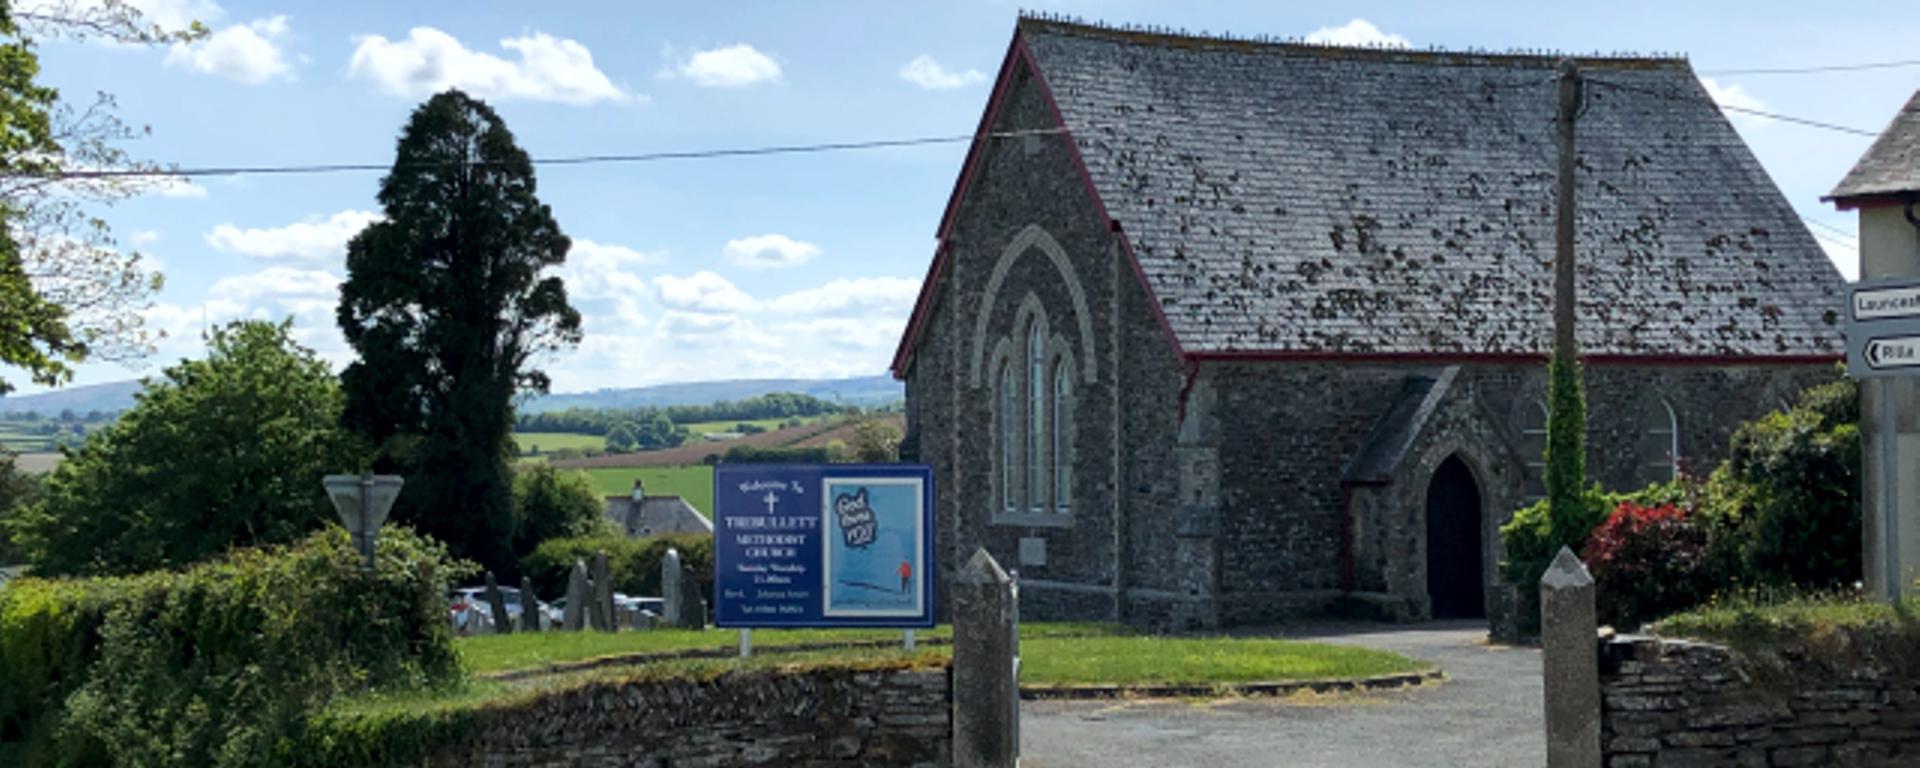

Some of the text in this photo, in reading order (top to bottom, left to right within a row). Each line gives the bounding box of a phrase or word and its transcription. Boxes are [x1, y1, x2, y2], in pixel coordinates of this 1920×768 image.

[838, 491, 866, 513] God
[725, 516, 818, 529] TREBULLETT
[736, 534, 806, 545] METHODIST
[745, 547, 797, 557] CHURCH
